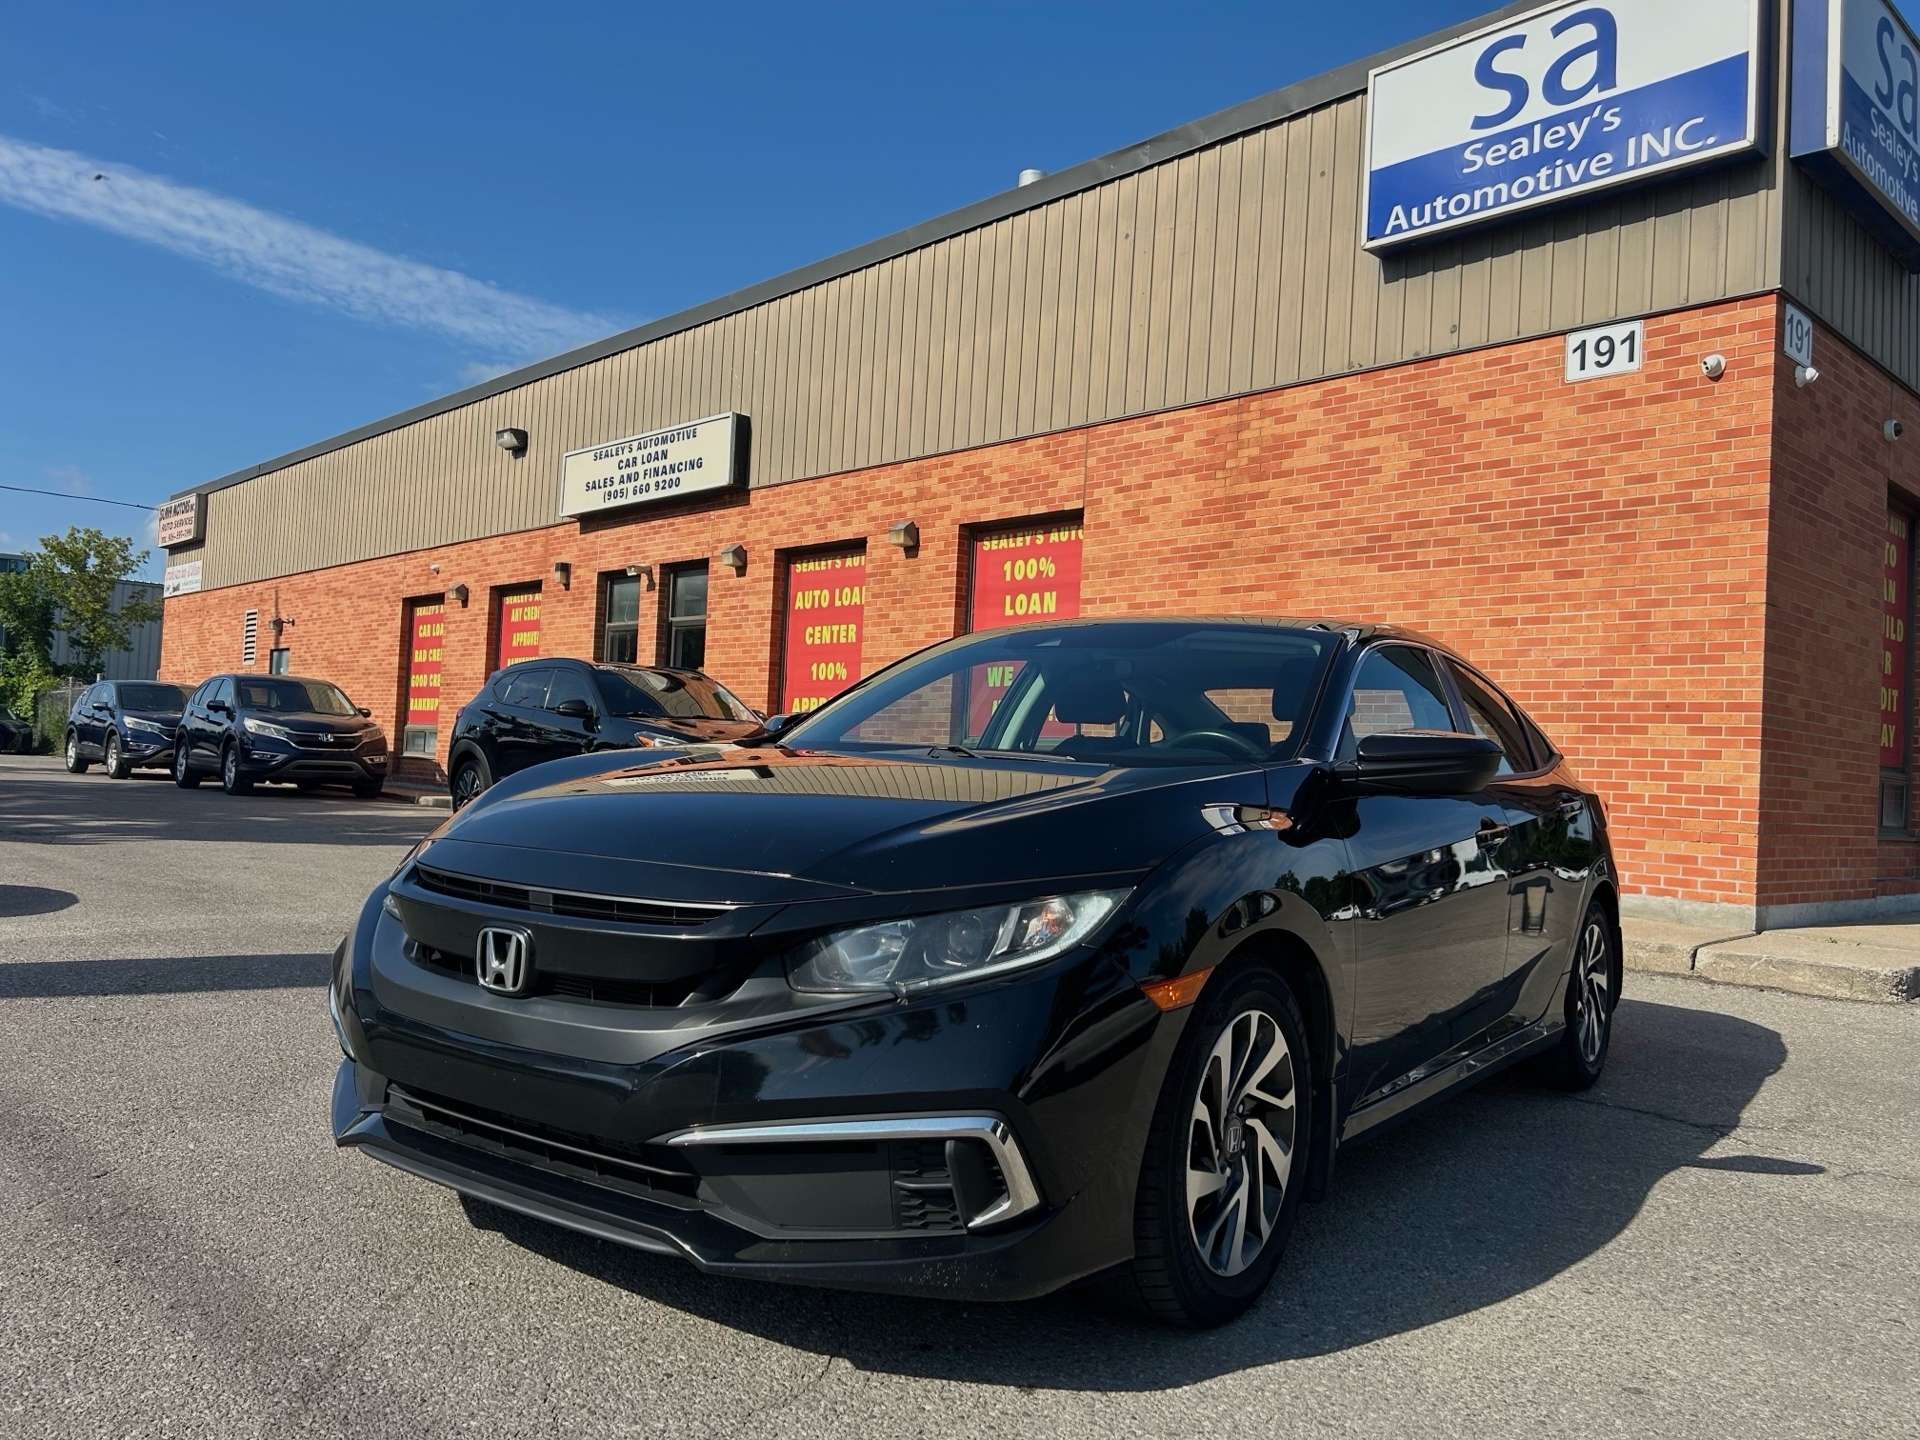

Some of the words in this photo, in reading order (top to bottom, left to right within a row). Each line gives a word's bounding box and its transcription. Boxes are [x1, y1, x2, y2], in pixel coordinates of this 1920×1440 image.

[1470, 7, 1617, 131] sa
[1874, 16, 1919, 145] sa
[1462, 104, 1622, 174] Sealey's
[1870, 106, 1920, 184] Sealey's
[1384, 152, 1613, 235] Automotive
[1627, 116, 1718, 168] INC.
[1842, 121, 1920, 222] Automotive
[1787, 313, 1812, 361] 191
[1572, 330, 1636, 371] 191
[593, 443, 633, 462] SEALEY'S
[636, 428, 698, 452] AUTOMOTIVE
[617, 456, 637, 471] CAR
[641, 449, 669, 465] LOAN
[585, 475, 615, 492] SALES
[618, 470, 640, 486] AND
[643, 456, 704, 479] FINANCING
[603, 487, 629, 503] (905)
[632, 482, 651, 497] 660
[654, 476, 681, 492] 9200
[983, 530, 1045, 551] SEALEY'S
[1003, 556, 1056, 582] 100%
[794, 588, 830, 610] AUTO
[1004, 591, 1057, 616] LOAN
[511, 607, 523, 623] ANY
[418, 624, 431, 638] CAR
[804, 623, 857, 646] CENTER
[415, 649, 427, 662] BAD
[410, 674, 428, 688] GOOD
[811, 661, 848, 681] 100%
[987, 666, 1015, 688] WE
